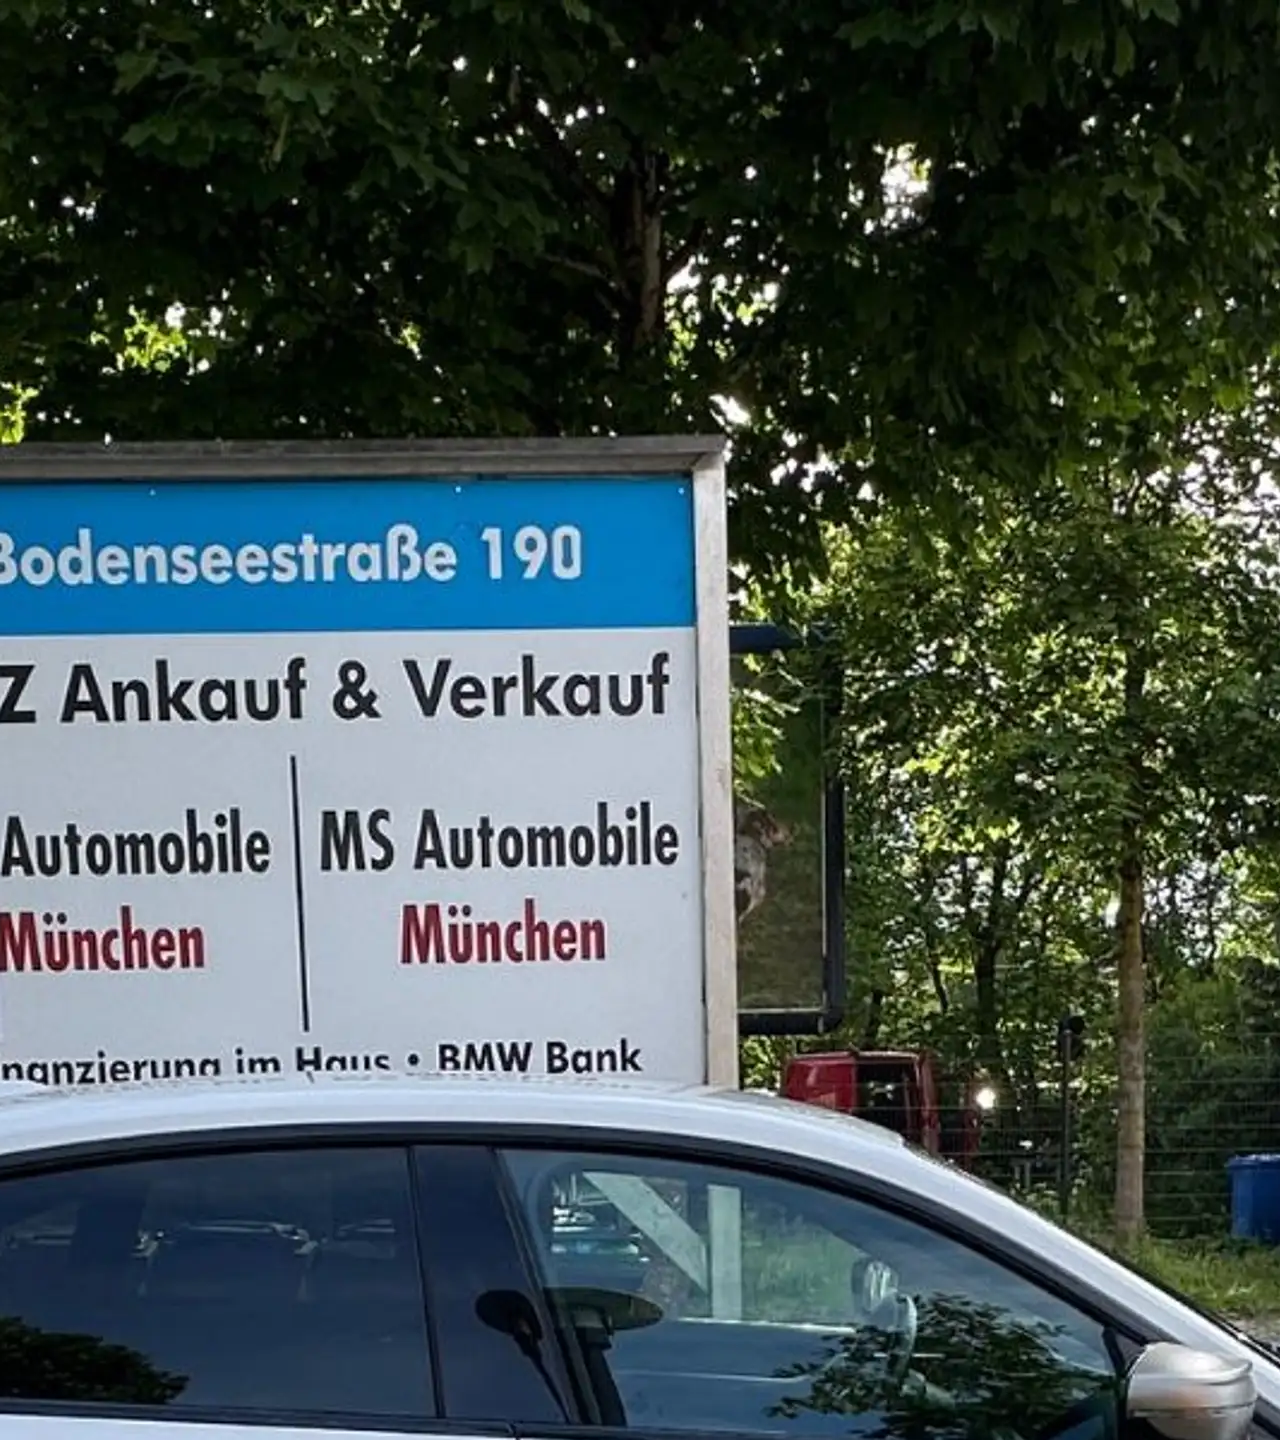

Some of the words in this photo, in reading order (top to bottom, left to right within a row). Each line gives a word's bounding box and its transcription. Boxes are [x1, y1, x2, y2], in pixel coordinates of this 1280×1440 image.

[481, 525, 582, 580] 190
[60, 656, 308, 724] Ankauf
[331, 660, 382, 721] &
[401, 652, 671, 720] Verkauf
[0, 807, 271, 878] Automobile
[320, 808, 395, 872] MS
[413, 800, 679, 871] Automobile
[400, 898, 607, 965] München
[235, 1047, 281, 1075] im
[295, 1046, 390, 1072] Haus
[437, 1041, 533, 1073] BMW
[546, 1037, 644, 1074] Bank
